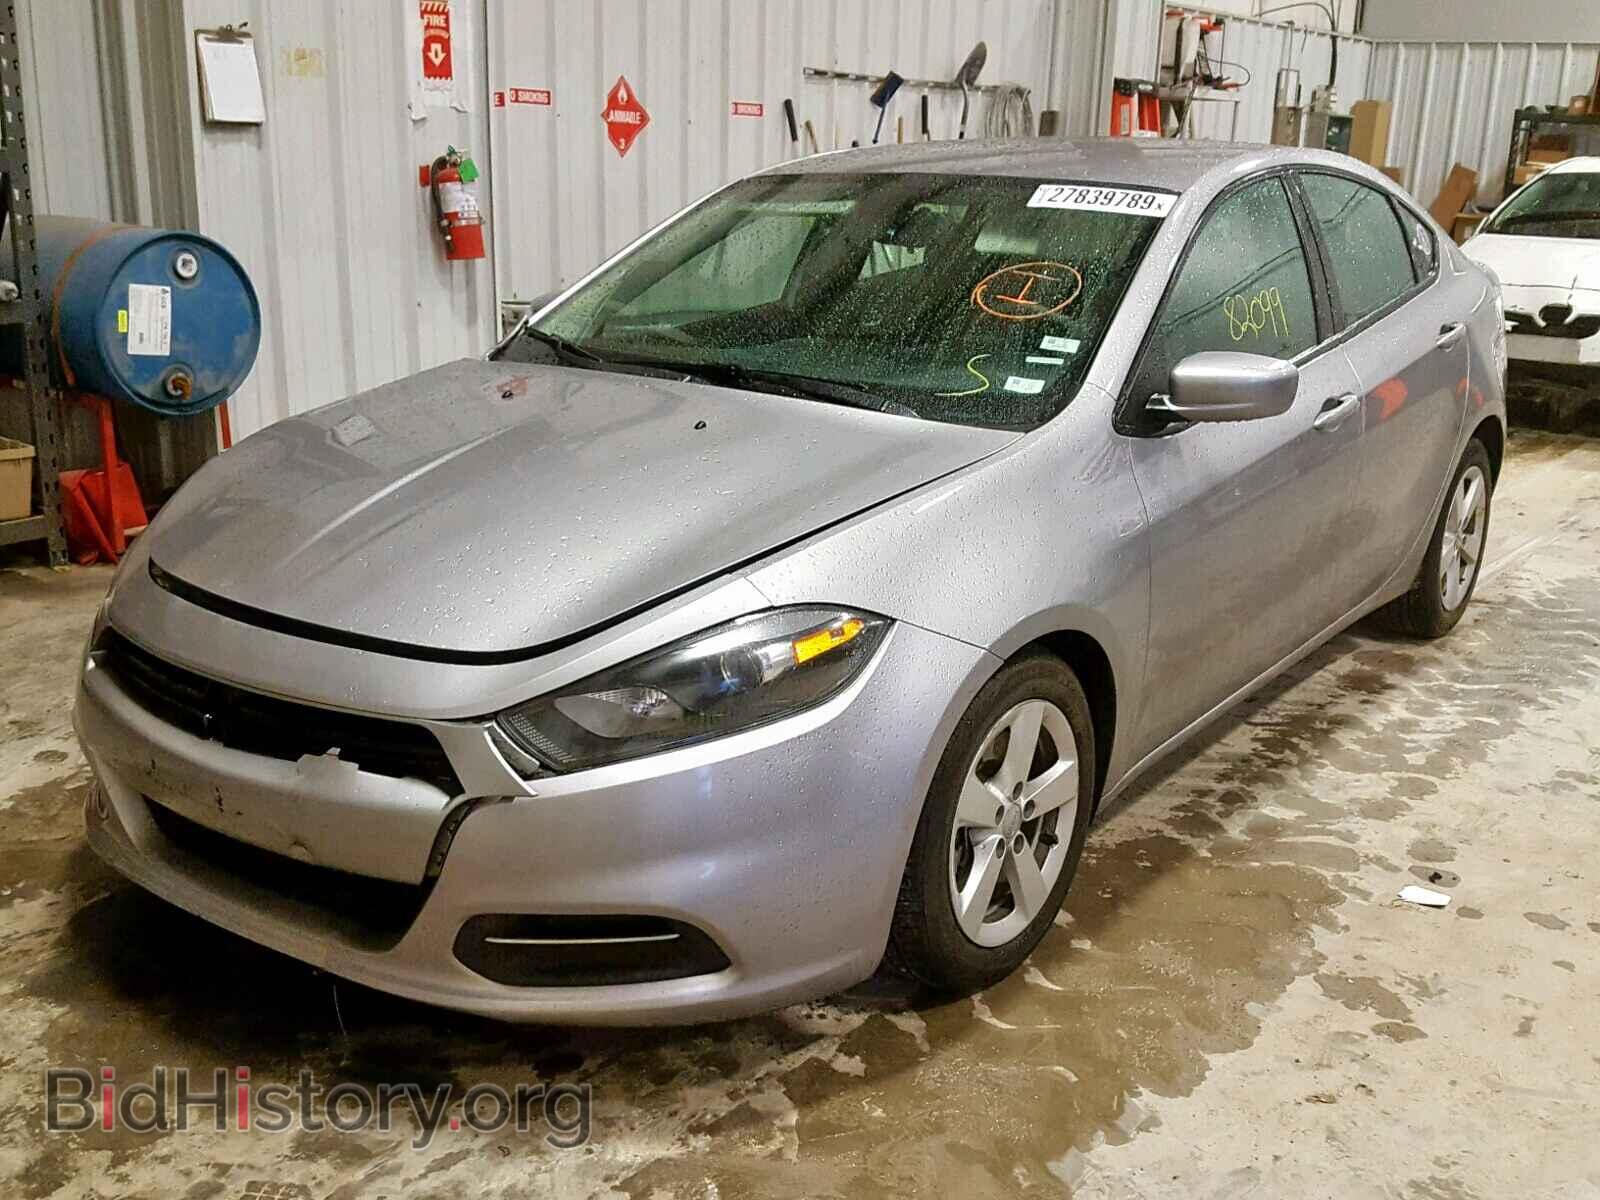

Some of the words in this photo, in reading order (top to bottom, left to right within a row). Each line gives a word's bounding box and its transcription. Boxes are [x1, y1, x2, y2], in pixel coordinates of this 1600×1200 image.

[423, 14, 448, 27] FIRE
[1047, 187, 1156, 210] 27839789
[1223, 286, 1289, 341] 82099
